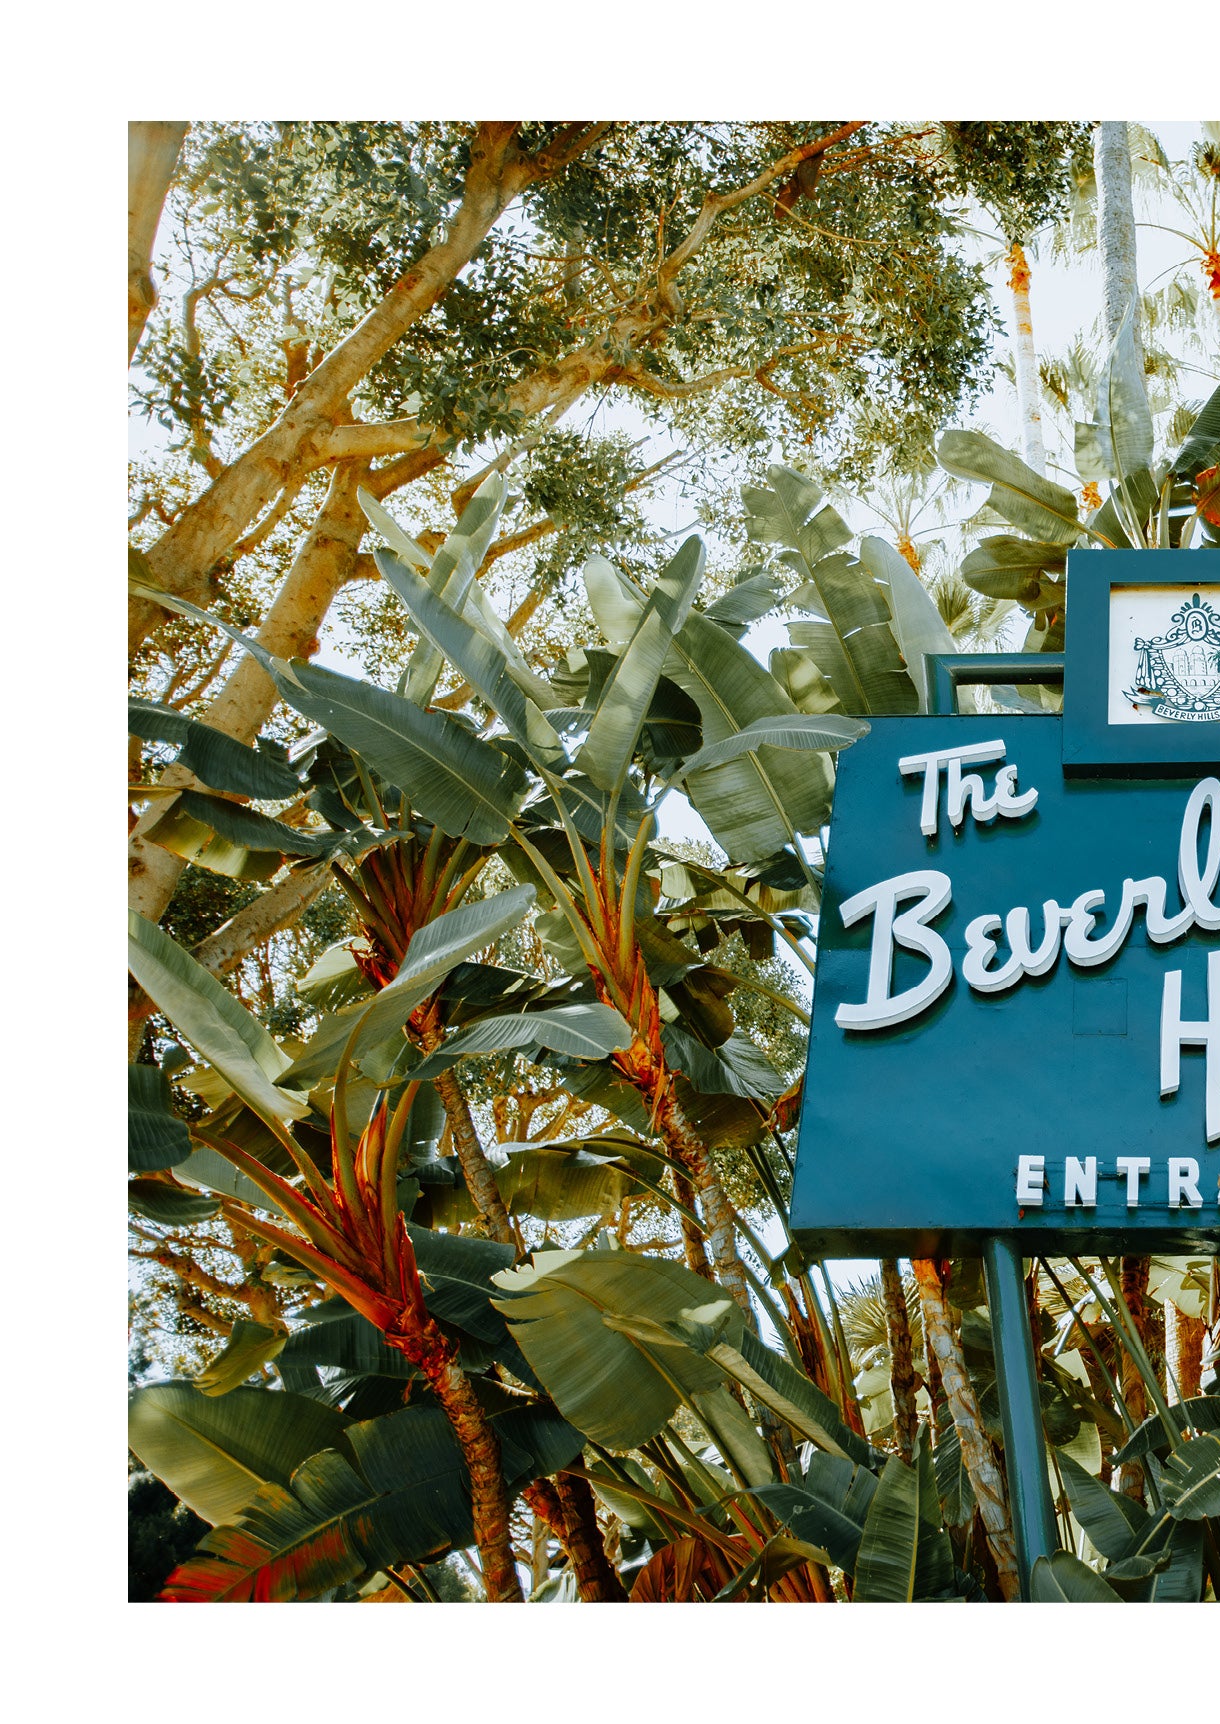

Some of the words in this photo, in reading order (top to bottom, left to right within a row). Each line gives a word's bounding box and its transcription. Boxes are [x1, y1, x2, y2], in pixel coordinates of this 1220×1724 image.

[1156, 704, 1196, 720] BEVERLY
[1197, 711, 1220, 720] HILLS
[898, 739, 1038, 836] The
